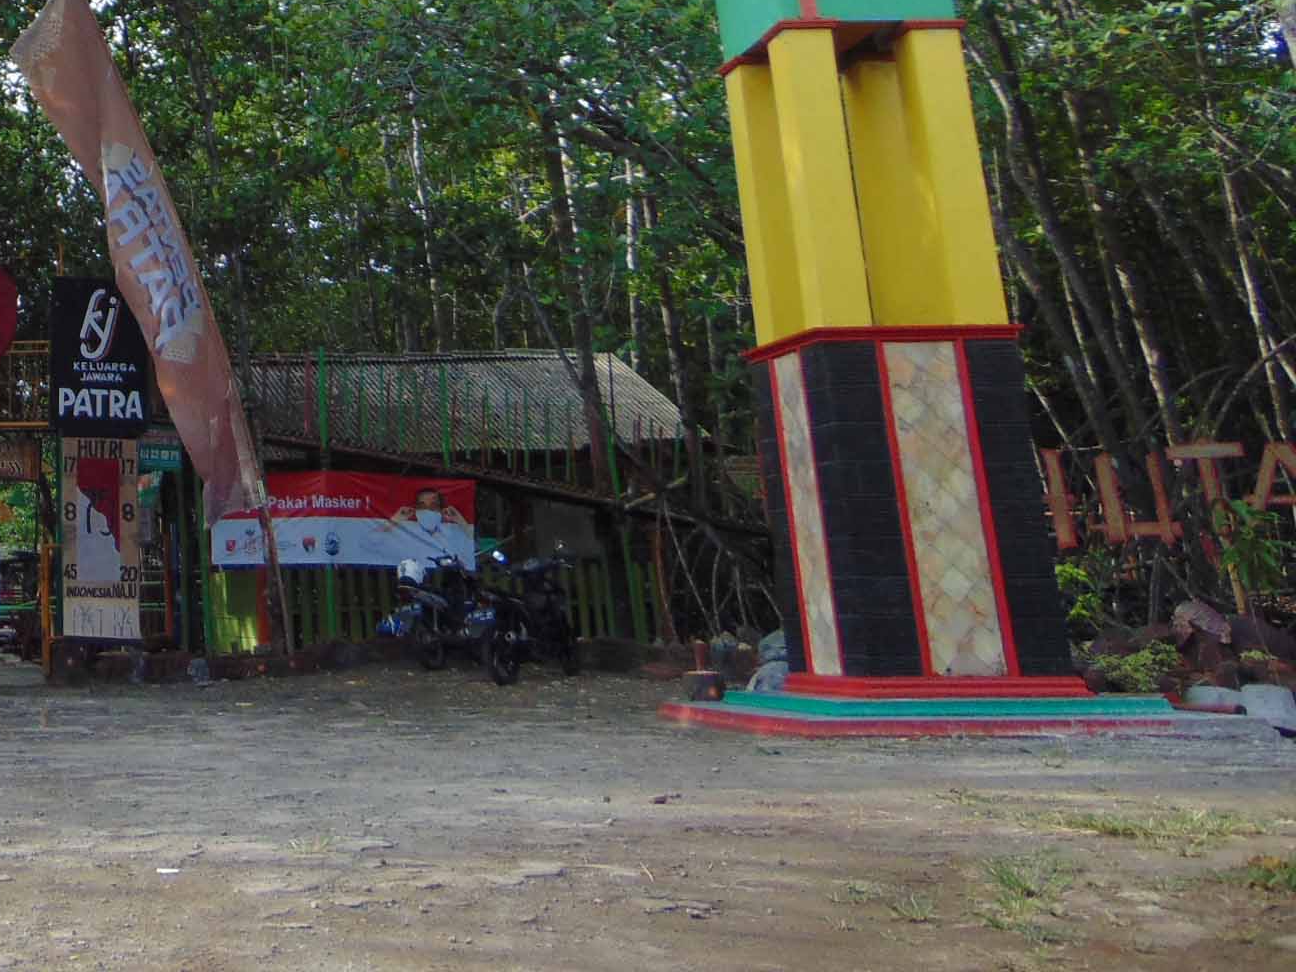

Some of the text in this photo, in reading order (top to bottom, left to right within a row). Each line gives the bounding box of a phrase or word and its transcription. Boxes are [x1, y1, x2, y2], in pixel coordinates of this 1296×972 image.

[72, 361, 136, 372] KELUARGA
[80, 372, 123, 382] JAWARA
[58, 387, 144, 420] PATRA
[78, 439, 106, 459] HUT
[268, 494, 308, 509] Pakai
[311, 494, 361, 509] Masker
[64, 502, 77, 522] 8
[122, 503, 136, 523] 8
